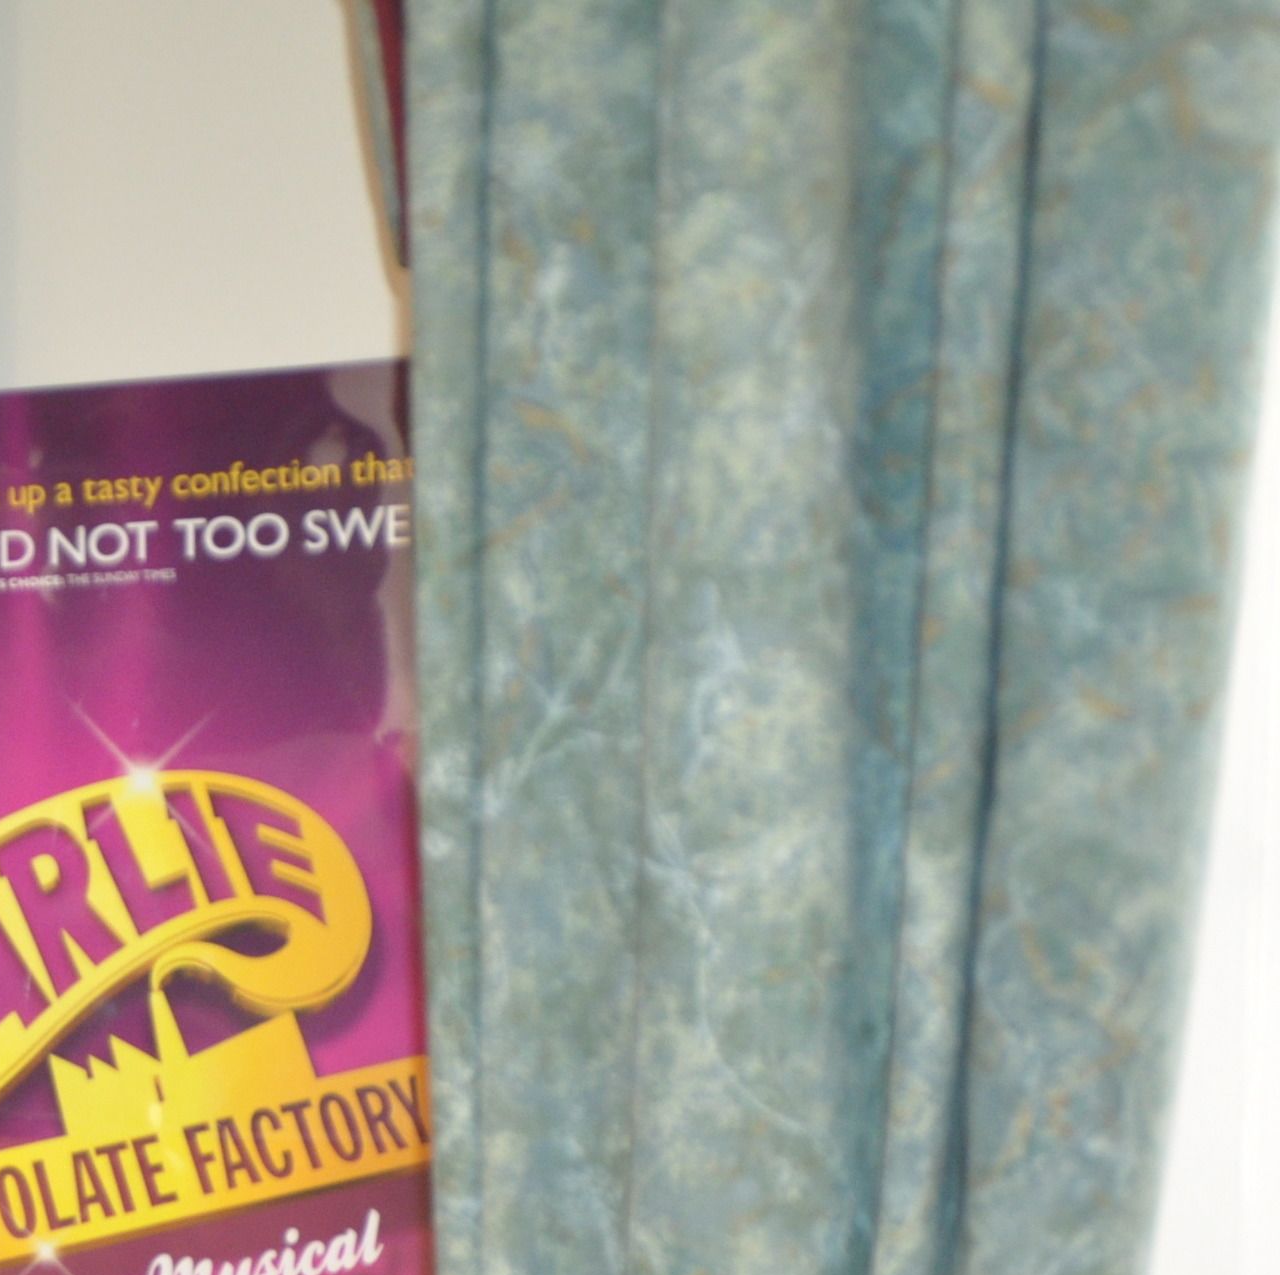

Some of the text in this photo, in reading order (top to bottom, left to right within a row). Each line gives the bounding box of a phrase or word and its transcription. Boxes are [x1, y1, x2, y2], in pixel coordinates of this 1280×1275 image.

[7, 484, 46, 514] up
[55, 482, 73, 503] a
[83, 474, 162, 508] tasty
[172, 459, 341, 497] confection
[48, 520, 158, 568] NOT
[173, 513, 289, 560] TOO
[182, 1074, 428, 1195] FACTORY
